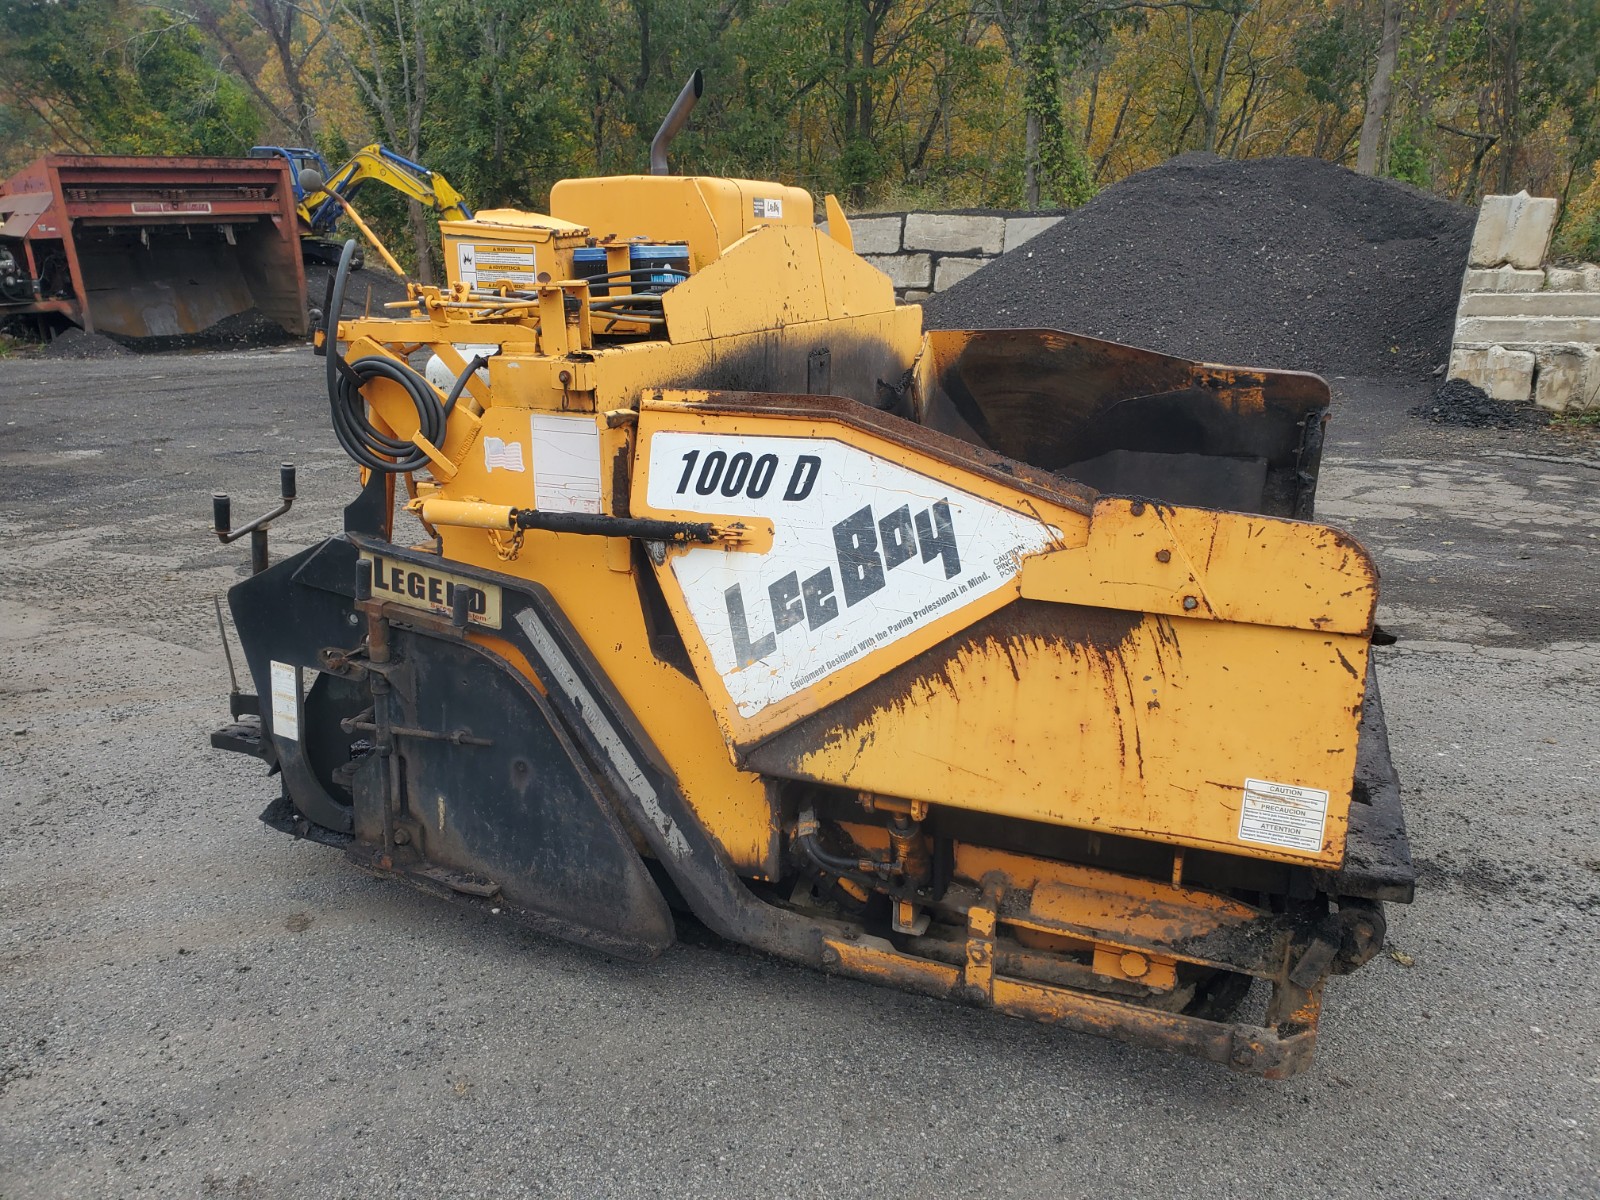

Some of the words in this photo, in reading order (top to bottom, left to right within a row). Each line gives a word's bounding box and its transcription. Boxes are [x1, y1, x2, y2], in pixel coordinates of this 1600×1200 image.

[676, 450, 779, 499] 1000
[783, 455, 822, 501] D
[993, 543, 1025, 565] CAUTION
[1000, 563, 1018, 578] POIN
[724, 497, 961, 669] LeeBoy
[790, 665, 827, 690] Equipment
[826, 646, 859, 669] Designed
[858, 636, 876, 651] With
[875, 630, 888, 644] the
[887, 614, 914, 634] Paving
[912, 588, 959, 620] Professional
[967, 571, 991, 588] Mind.
[1269, 785, 1303, 796] CAUTION
[1260, 803, 1306, 817] PRECAUCION
[1260, 823, 1302, 835] ATTENTION
